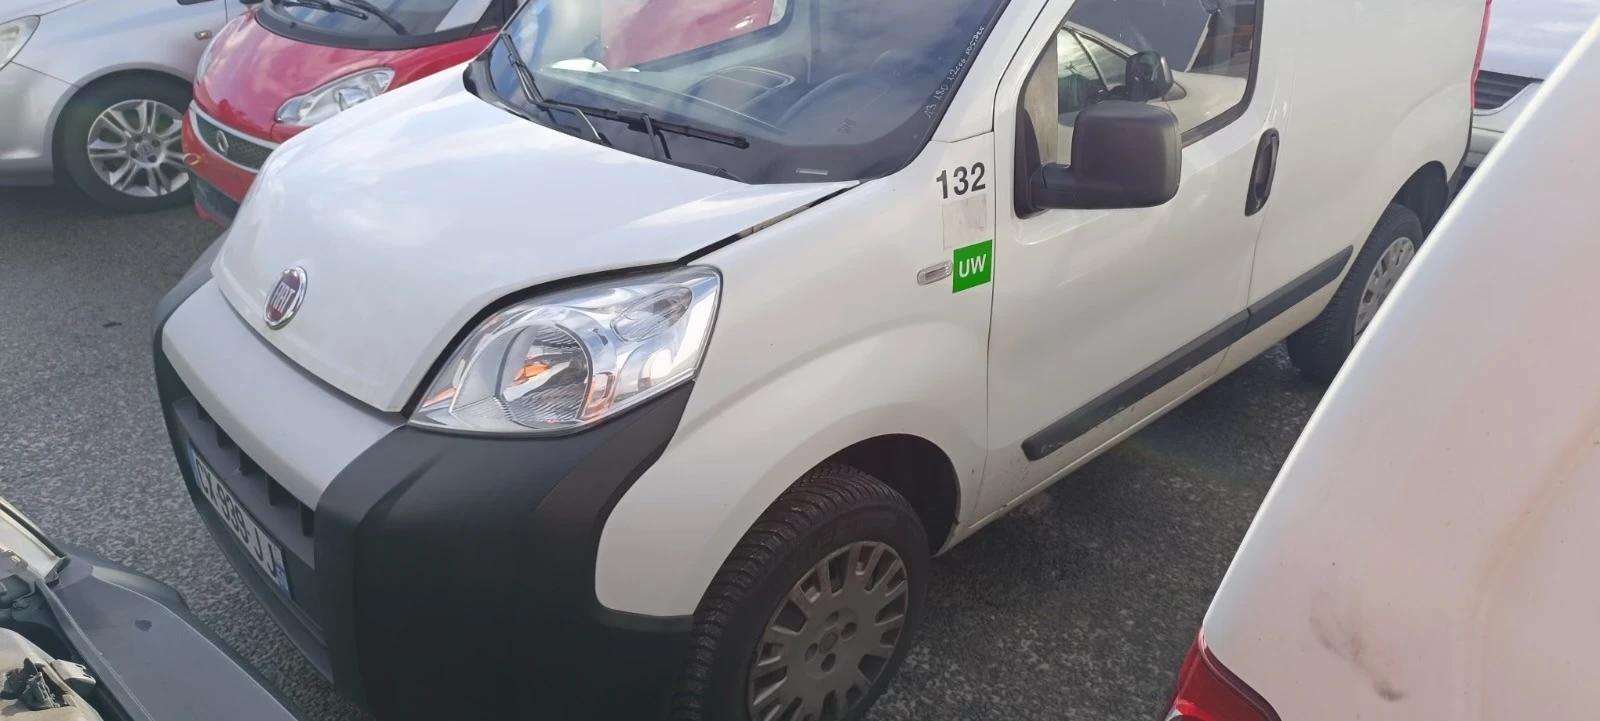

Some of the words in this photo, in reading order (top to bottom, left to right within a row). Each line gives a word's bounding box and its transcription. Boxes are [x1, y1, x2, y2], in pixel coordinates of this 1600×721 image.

[936, 162, 986, 199] 132
[959, 253, 987, 278] UW
[270, 280, 296, 313] FIAT
